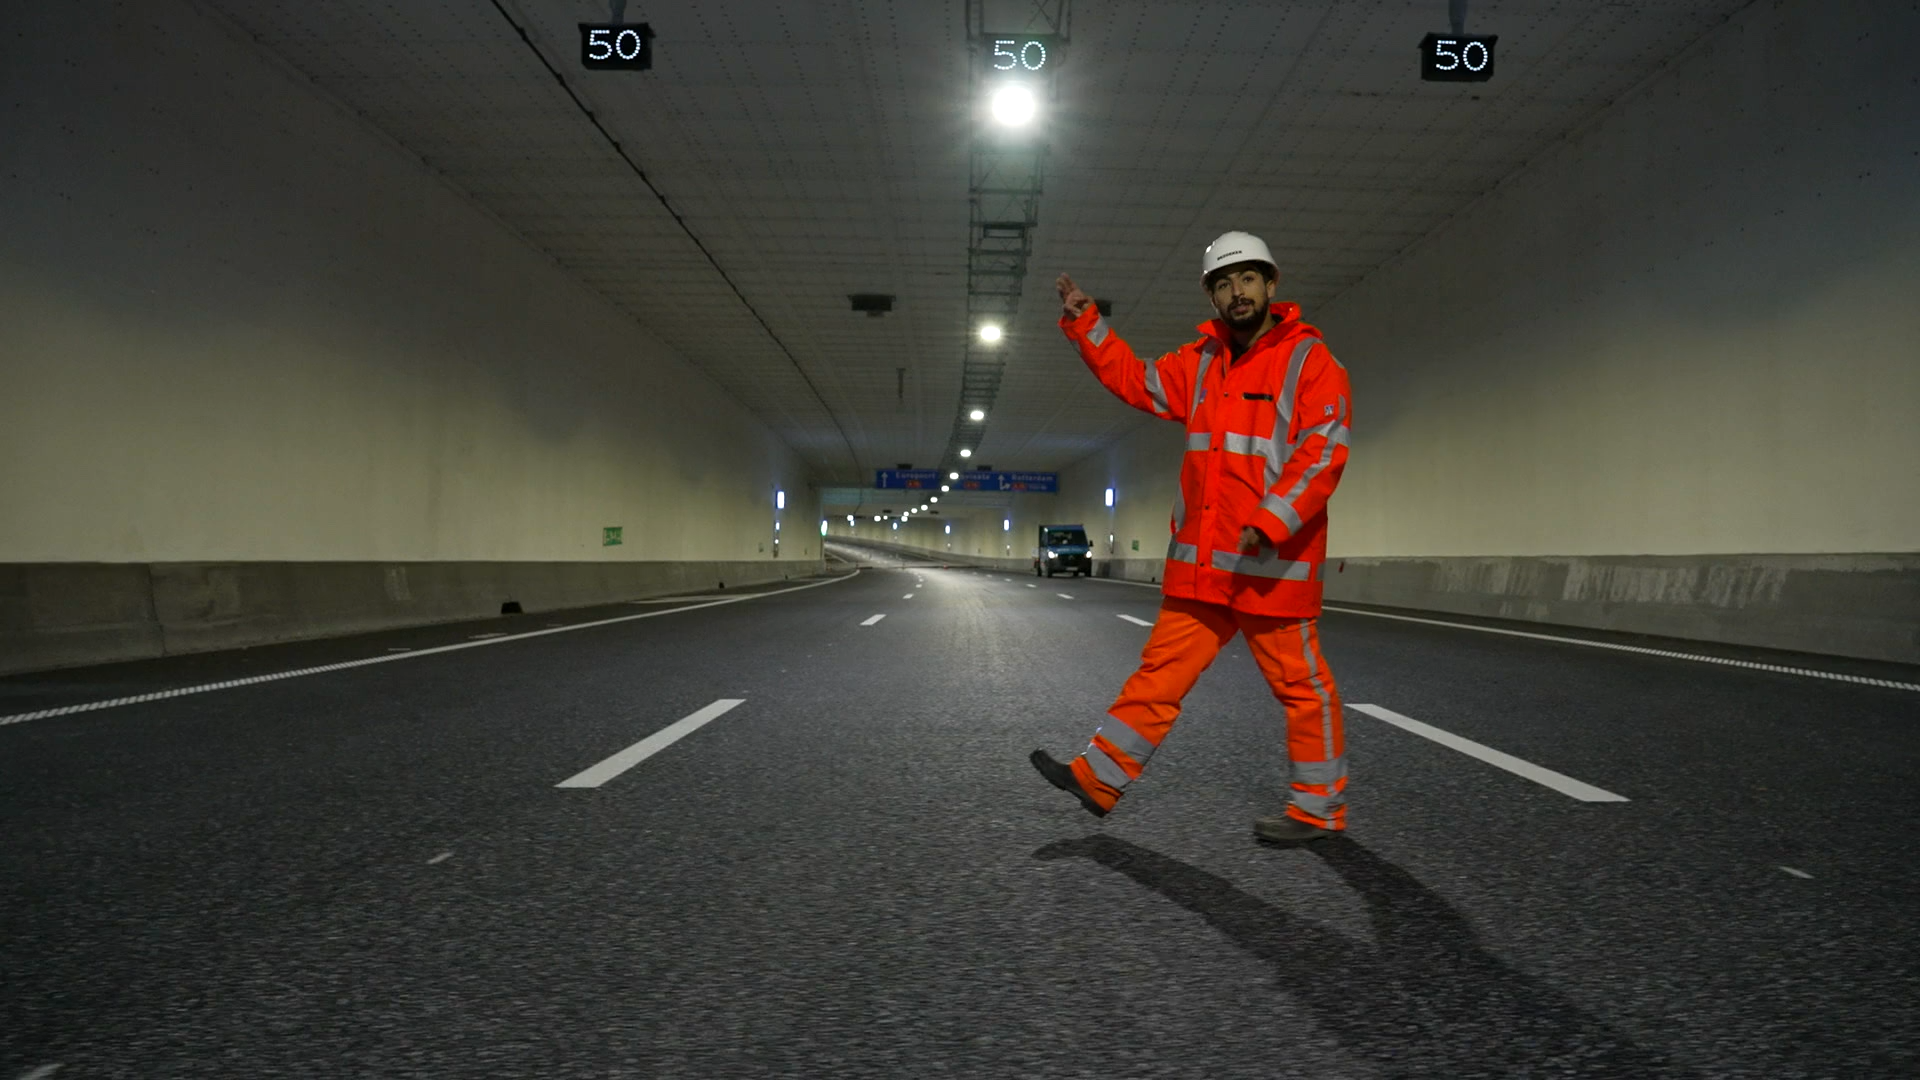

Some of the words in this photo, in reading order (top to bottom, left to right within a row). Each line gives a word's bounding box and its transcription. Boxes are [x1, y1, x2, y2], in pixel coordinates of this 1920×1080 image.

[589, 29, 641, 60] 50
[993, 40, 1046, 71] 50
[1435, 40, 1488, 71] 50
